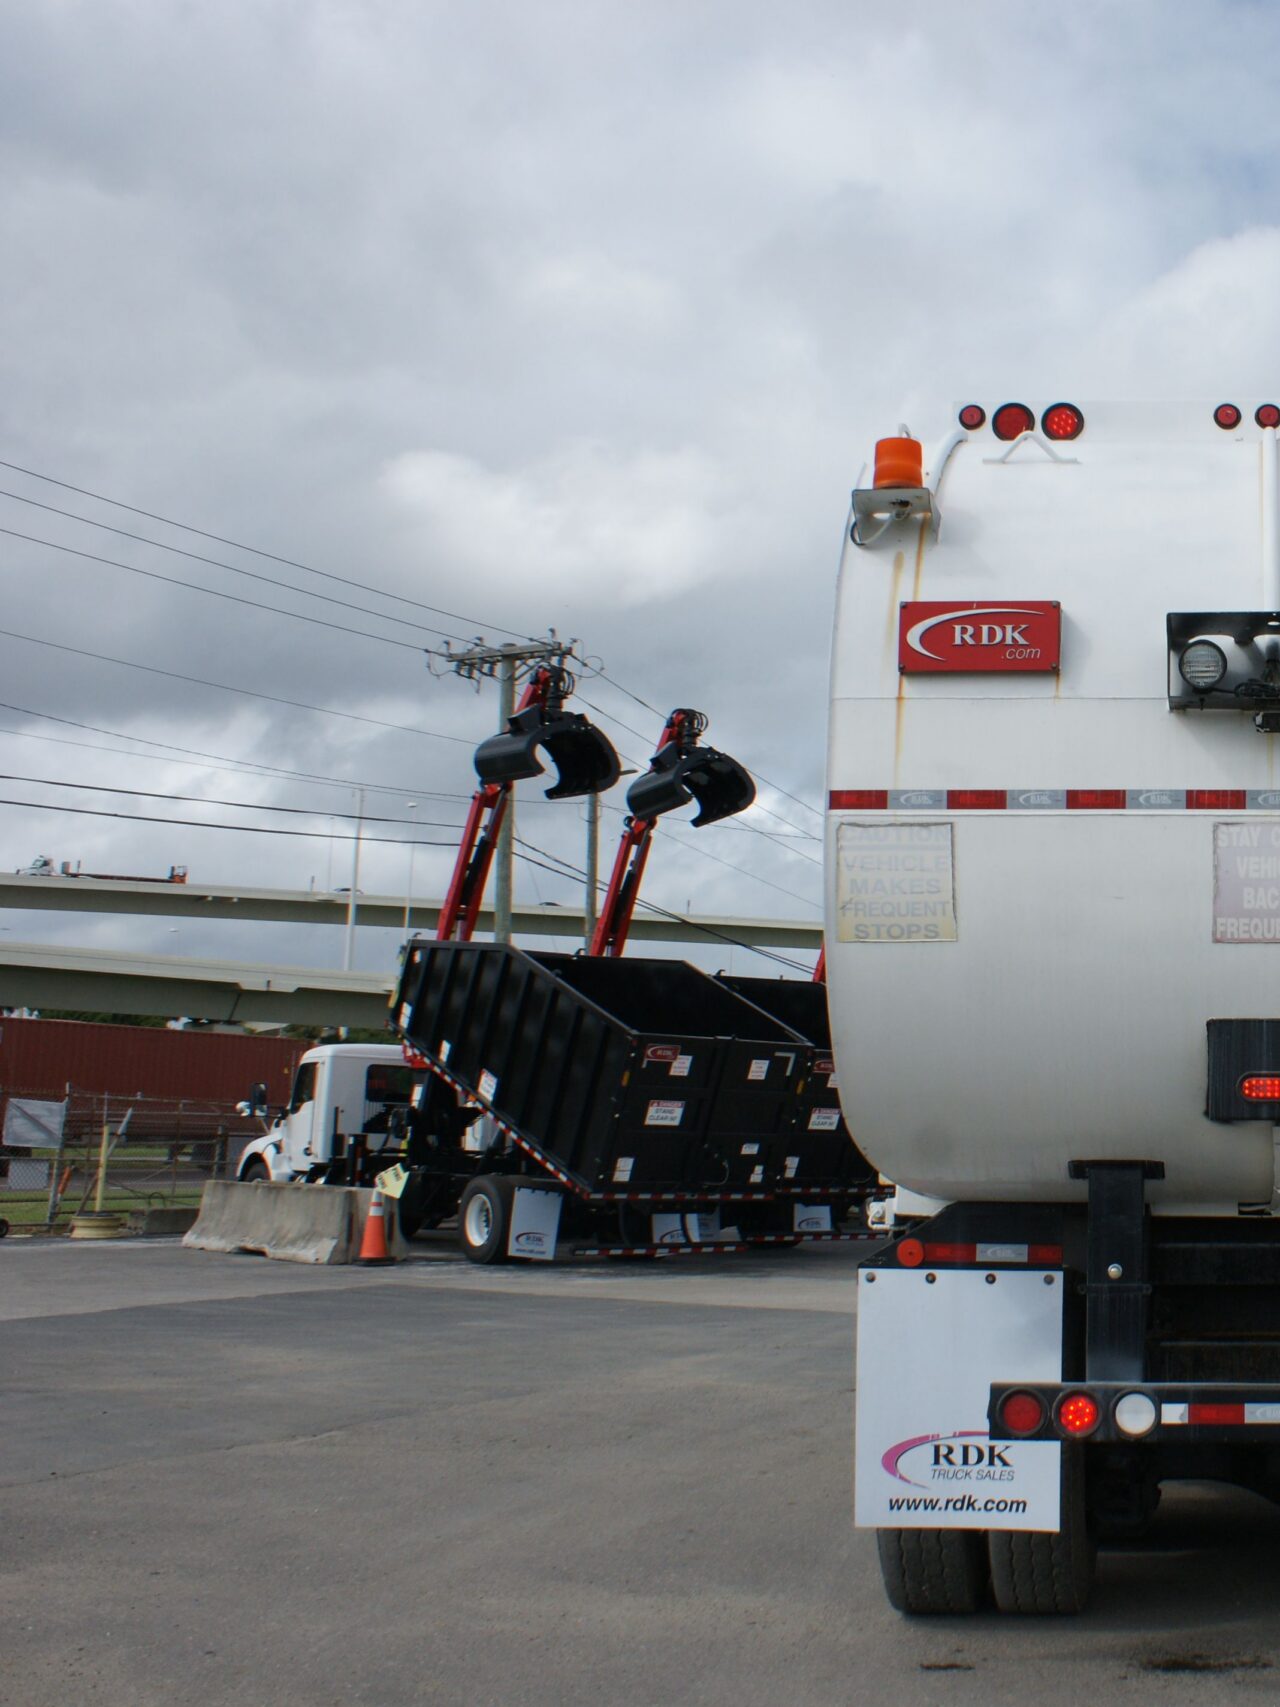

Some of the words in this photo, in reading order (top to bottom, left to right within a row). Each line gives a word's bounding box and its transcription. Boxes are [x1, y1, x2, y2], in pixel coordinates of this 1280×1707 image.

[952, 624, 1030, 646] RDK
[1001, 648, 1041, 660] .com
[1217, 827, 1262, 848] STAY
[844, 855, 949, 872] VEHICLE
[850, 878, 942, 895] MAKES
[841, 901, 949, 918] FREQUENT
[854, 923, 940, 940] STOPS
[931, 1444, 1014, 1467] RDK
[931, 1468, 973, 1481] TRUCK
[976, 1469, 1015, 1482] SALES
[889, 1495, 1028, 1514] www.rdk.com
